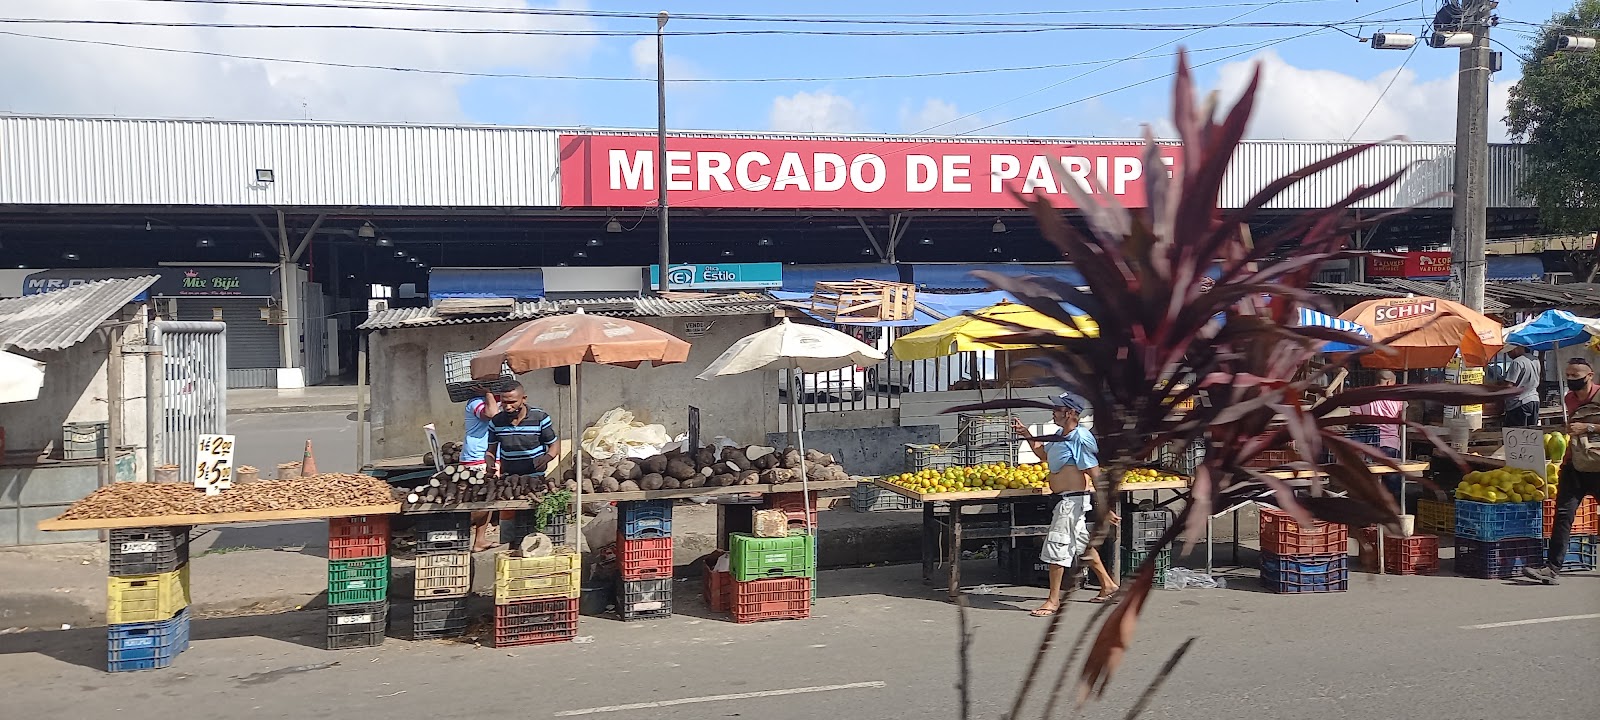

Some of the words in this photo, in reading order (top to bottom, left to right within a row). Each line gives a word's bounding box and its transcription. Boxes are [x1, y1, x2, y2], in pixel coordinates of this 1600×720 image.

[608, 148, 887, 193] MERCADO
[905, 154, 972, 193] DE
[183, 277, 207, 288] Mix
[703, 271, 736, 281] Estilo
[1376, 302, 1435, 321] SCHIN
